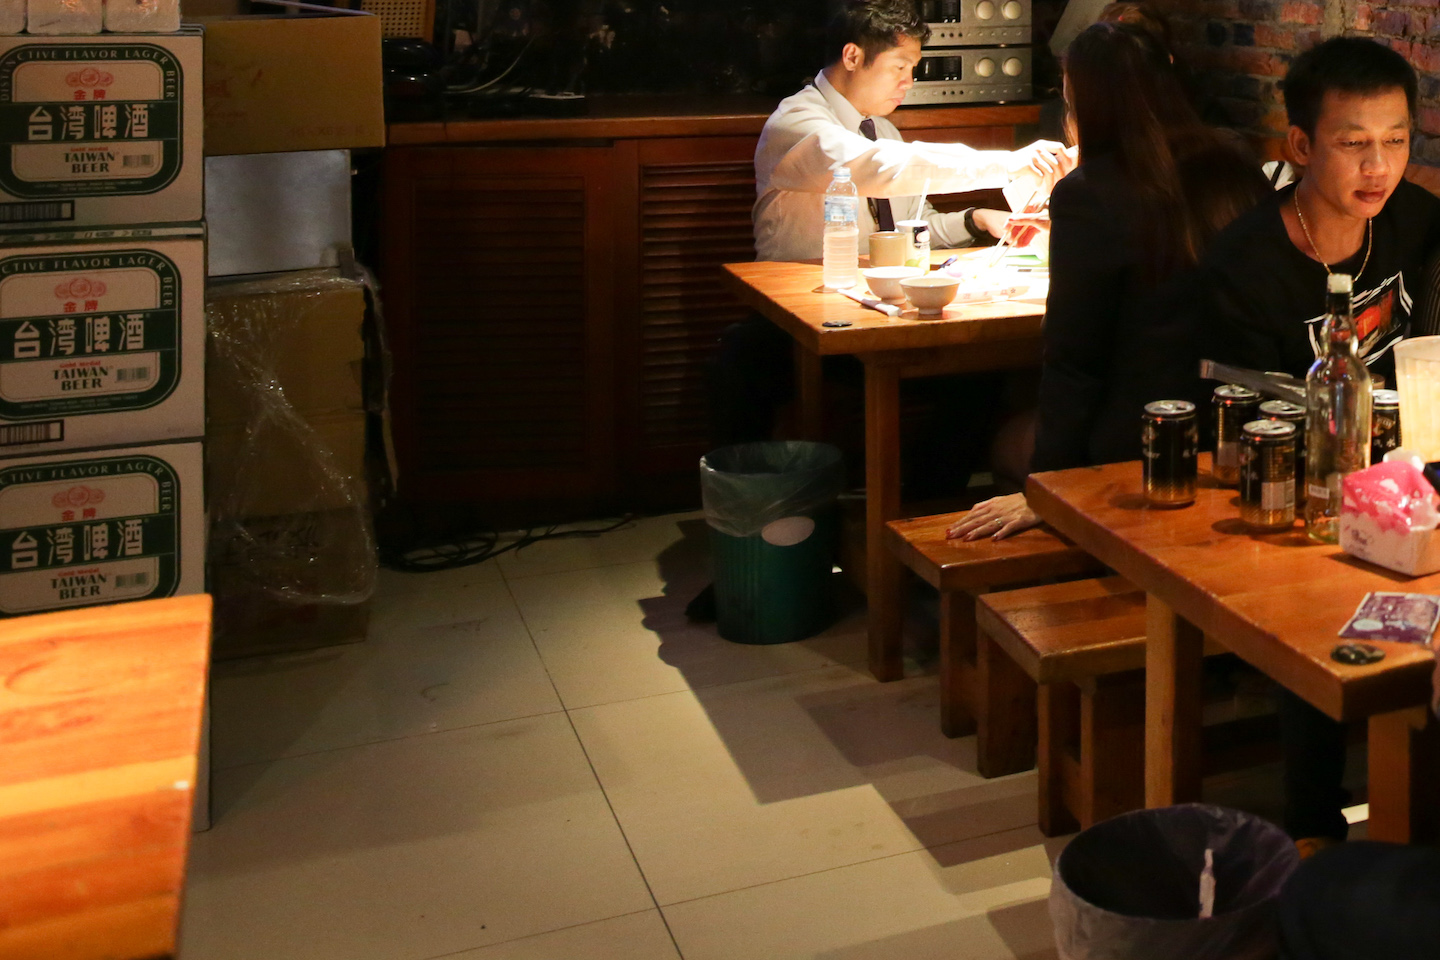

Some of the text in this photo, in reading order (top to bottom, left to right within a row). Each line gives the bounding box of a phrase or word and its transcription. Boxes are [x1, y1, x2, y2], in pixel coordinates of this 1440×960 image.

[65, 49, 118, 59] FLAVOR
[125, 49, 169, 65] LAGER
[165, 70, 176, 99] BEER
[64, 152, 115, 163] TAIWAN
[71, 163, 109, 173] BEER
[53, 258, 111, 270] FLAVOR
[119, 255, 166, 271] LAGER
[162, 276, 173, 306] BEER
[63, 300, 98, 313] 金牌
[52, 367, 108, 380] TAIWAN
[61, 378, 102, 391] BEER
[51, 465, 109, 479] FLAVOR
[116, 462, 164, 476] LAGER
[161, 480, 172, 511] BEER
[50, 573, 107, 589] TAIWAN
[59, 585, 101, 600] BEER
